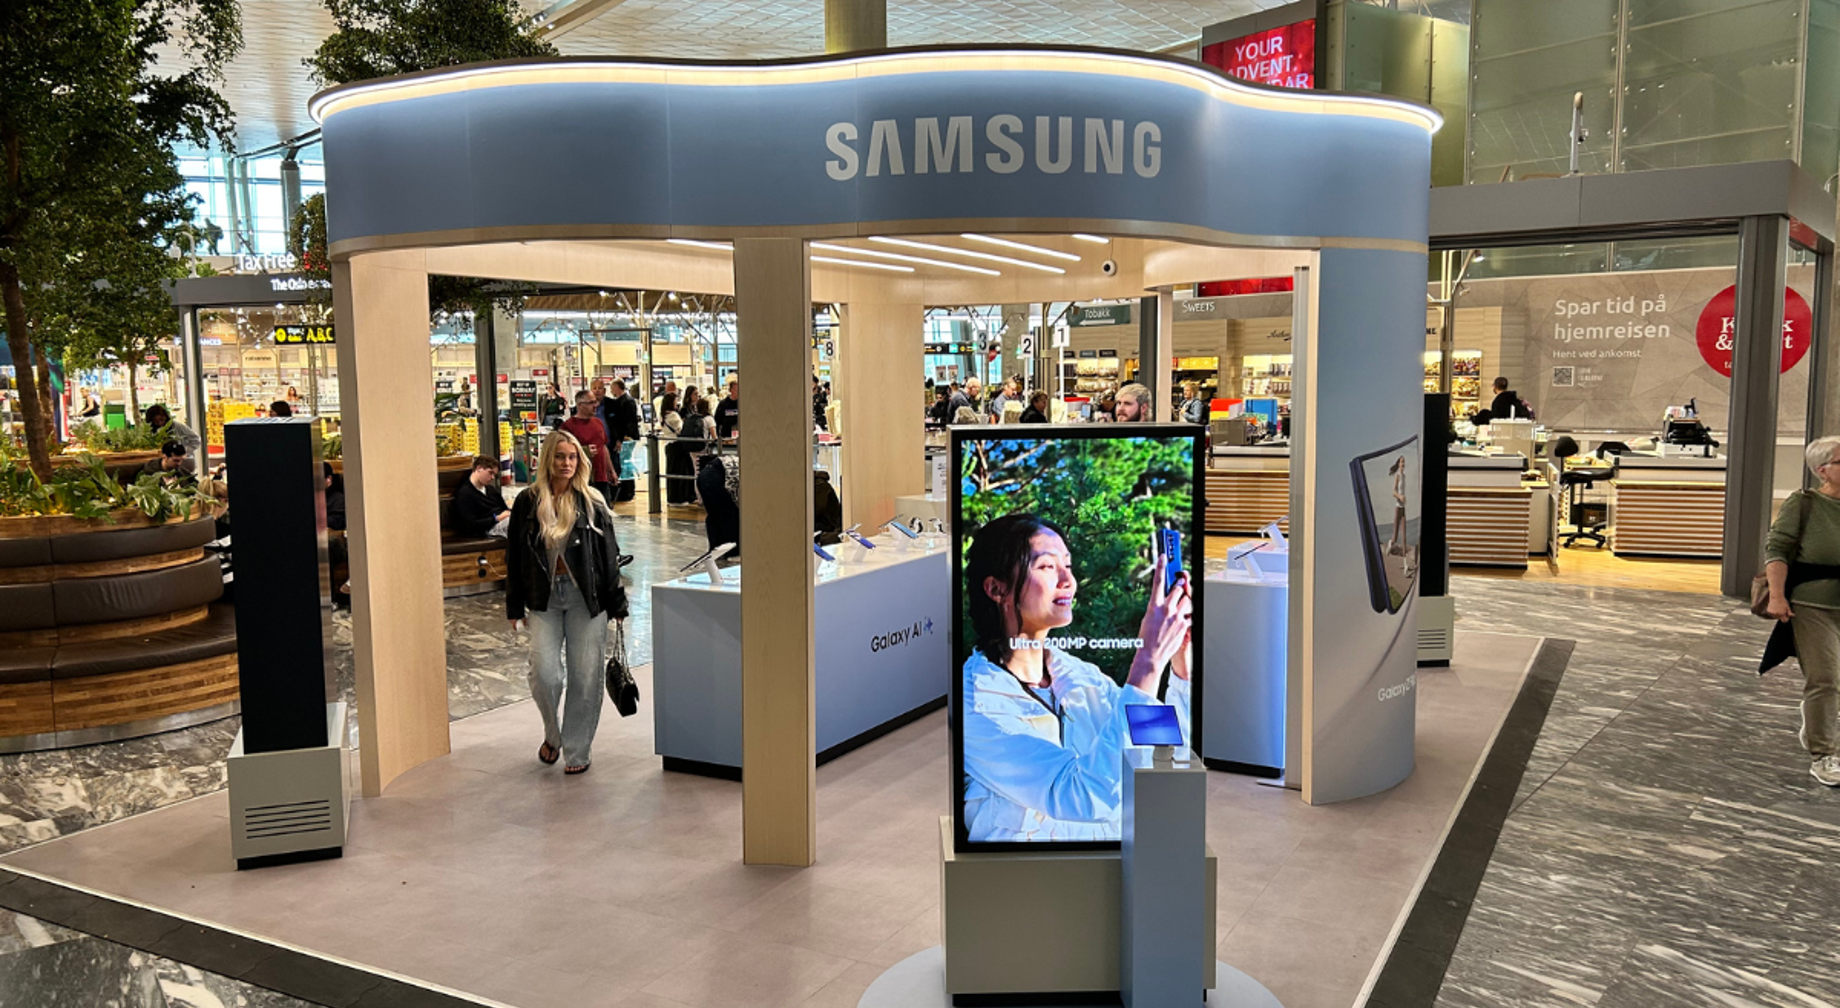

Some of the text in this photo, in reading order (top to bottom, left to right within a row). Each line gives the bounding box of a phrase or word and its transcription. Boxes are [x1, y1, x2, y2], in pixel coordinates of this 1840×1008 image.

[1235, 36, 1283, 62] YOUR
[825, 114, 1162, 181] SAMSUNG
[238, 252, 295, 270] Tax Free
[270, 277, 287, 291] The
[1084, 308, 1111, 319] Tobakk
[1554, 294, 1666, 318] Spar tid på
[1057, 328, 1065, 343] 1
[1554, 321, 1670, 343] hjemreisen
[826, 341, 833, 357] 8
[979, 332, 987, 350] 3
[1023, 338, 1031, 354] 2
[1552, 349, 1642, 358] Hent ved ankomst
[870, 620, 922, 653] Galaxy AI
[1009, 636, 1144, 649] Ultra 200MP camera
